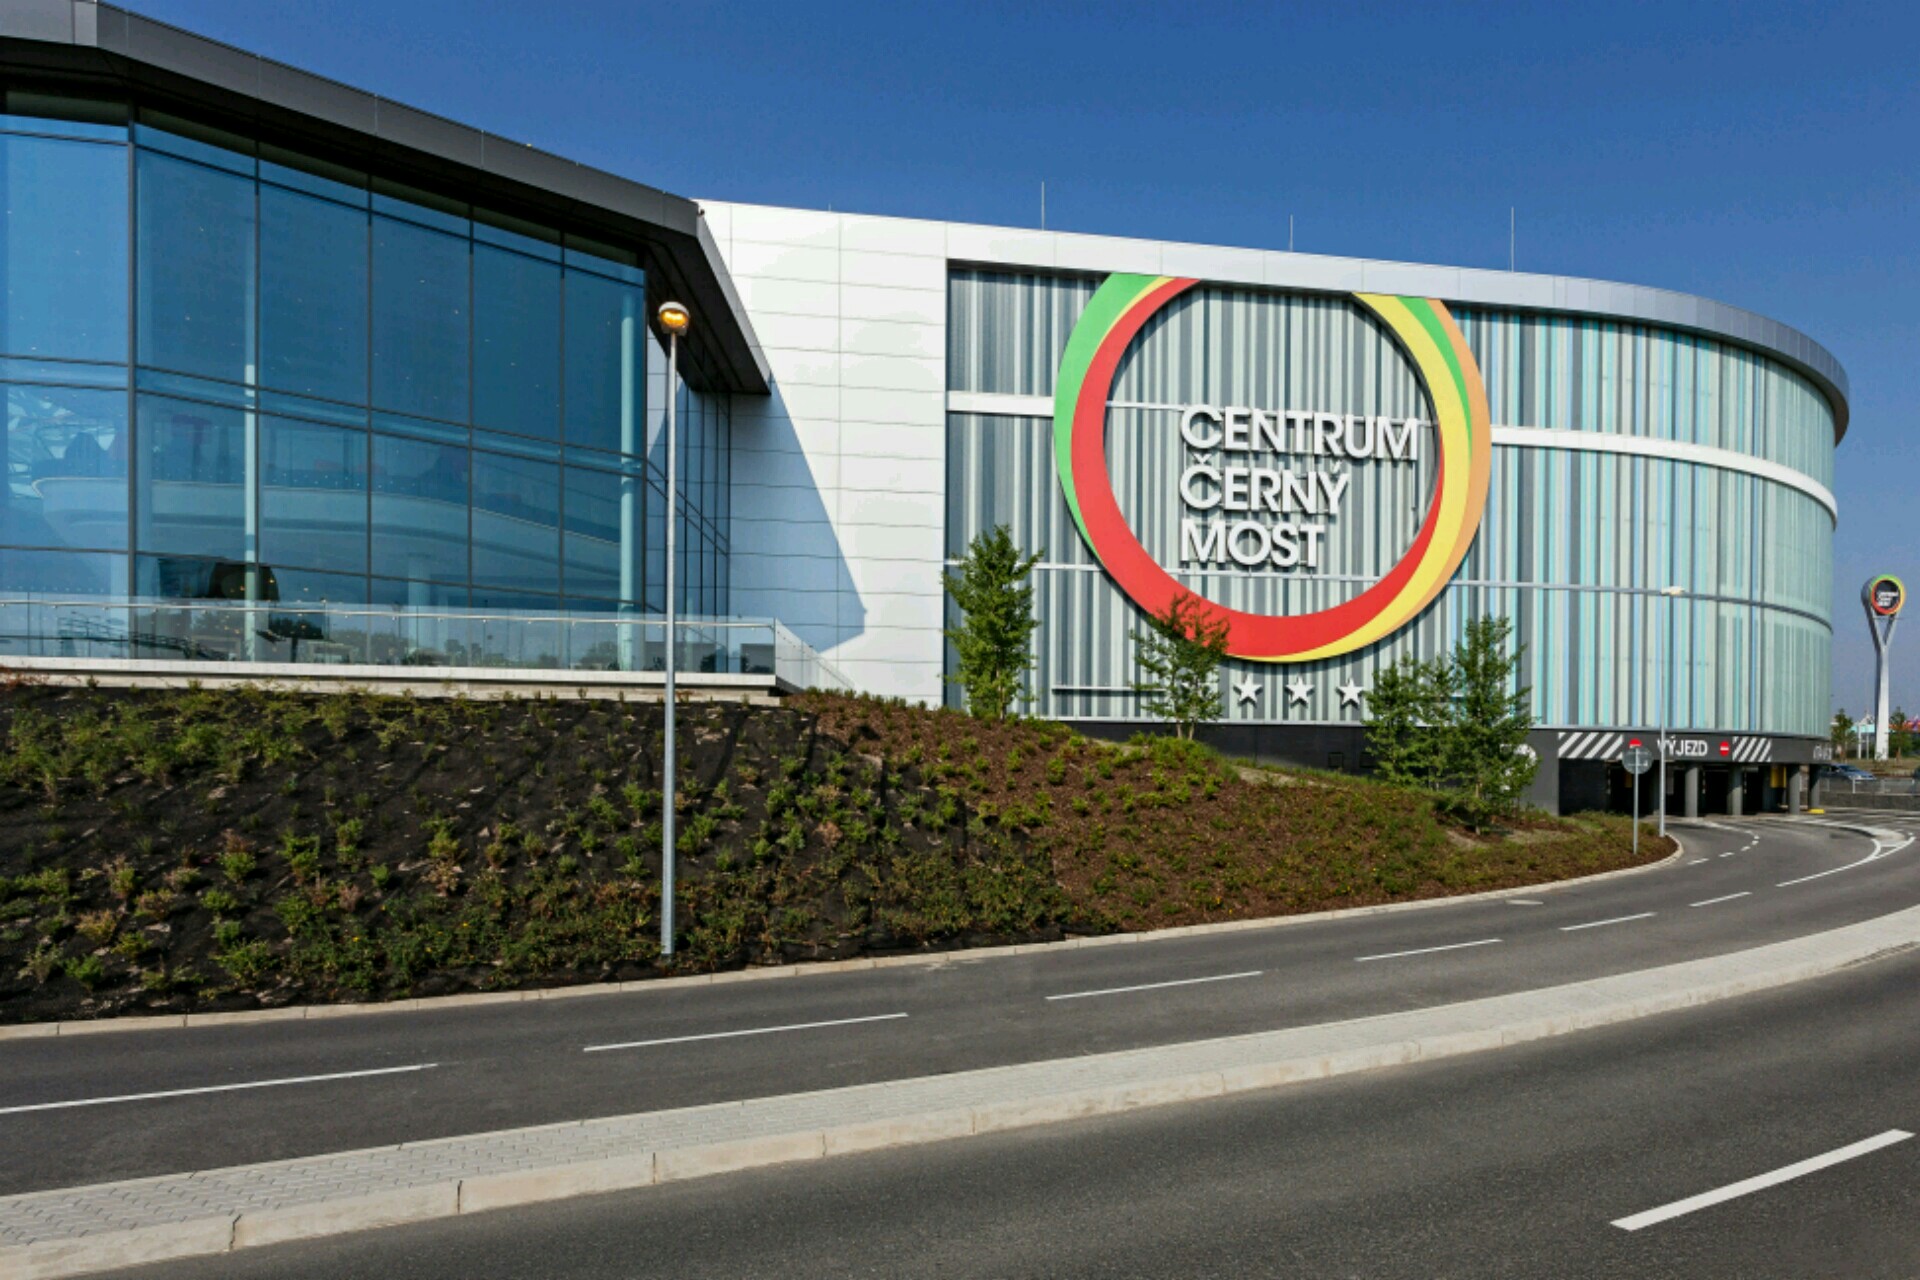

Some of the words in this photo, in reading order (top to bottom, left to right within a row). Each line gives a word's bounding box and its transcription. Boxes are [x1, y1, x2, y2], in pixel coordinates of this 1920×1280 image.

[1180, 403, 1418, 461] CENTRUM
[1180, 453, 1349, 514] ČERNÝ
[1181, 519, 1325, 567] MOST
